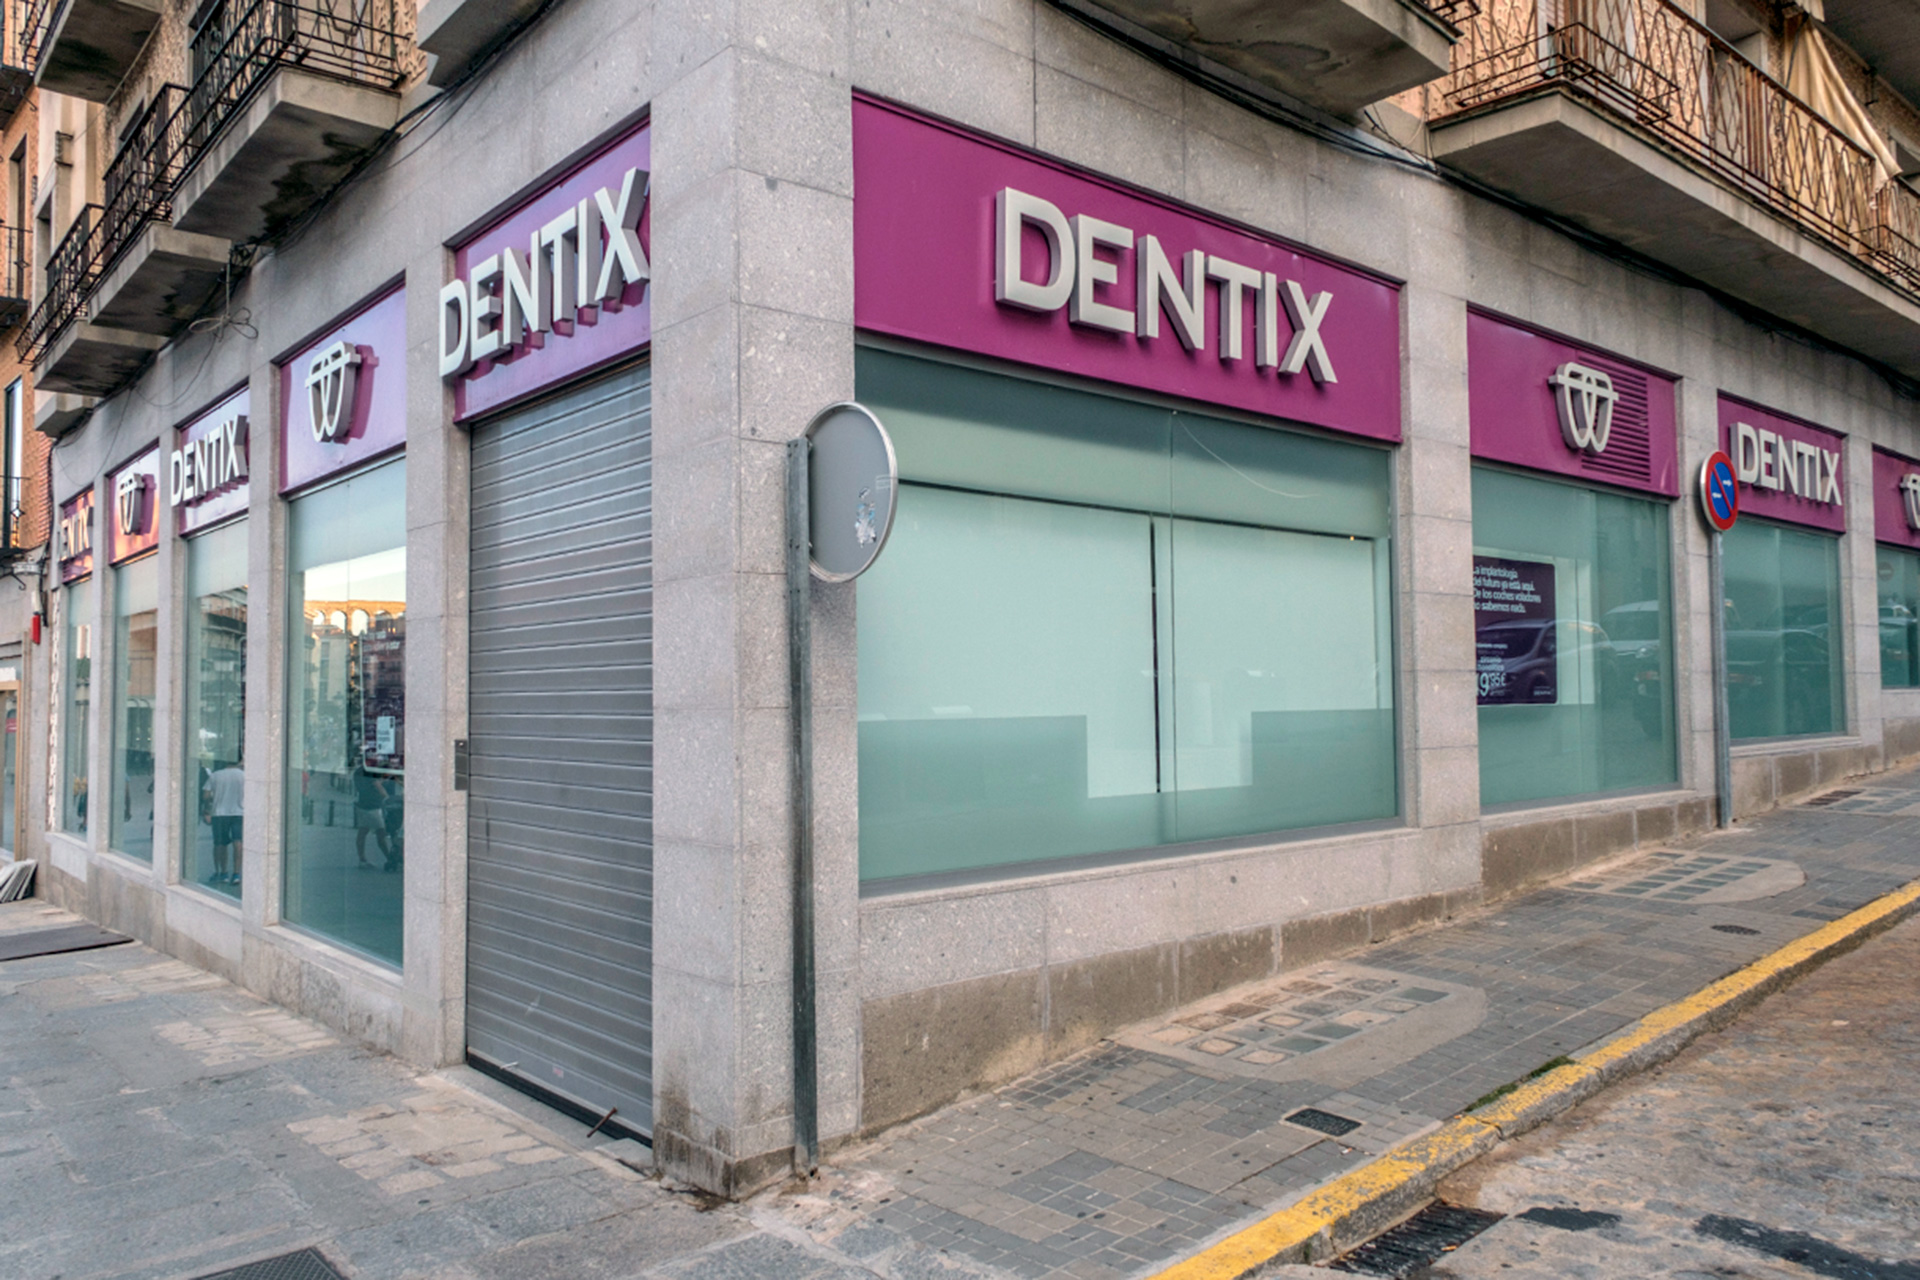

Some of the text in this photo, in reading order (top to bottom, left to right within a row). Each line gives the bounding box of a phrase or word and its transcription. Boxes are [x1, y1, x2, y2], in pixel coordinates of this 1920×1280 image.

[439, 167, 649, 378] DENTIX
[996, 186, 1338, 384] DENTIX
[171, 415, 246, 507] DENTIX
[1731, 422, 1842, 506] DENTIX
